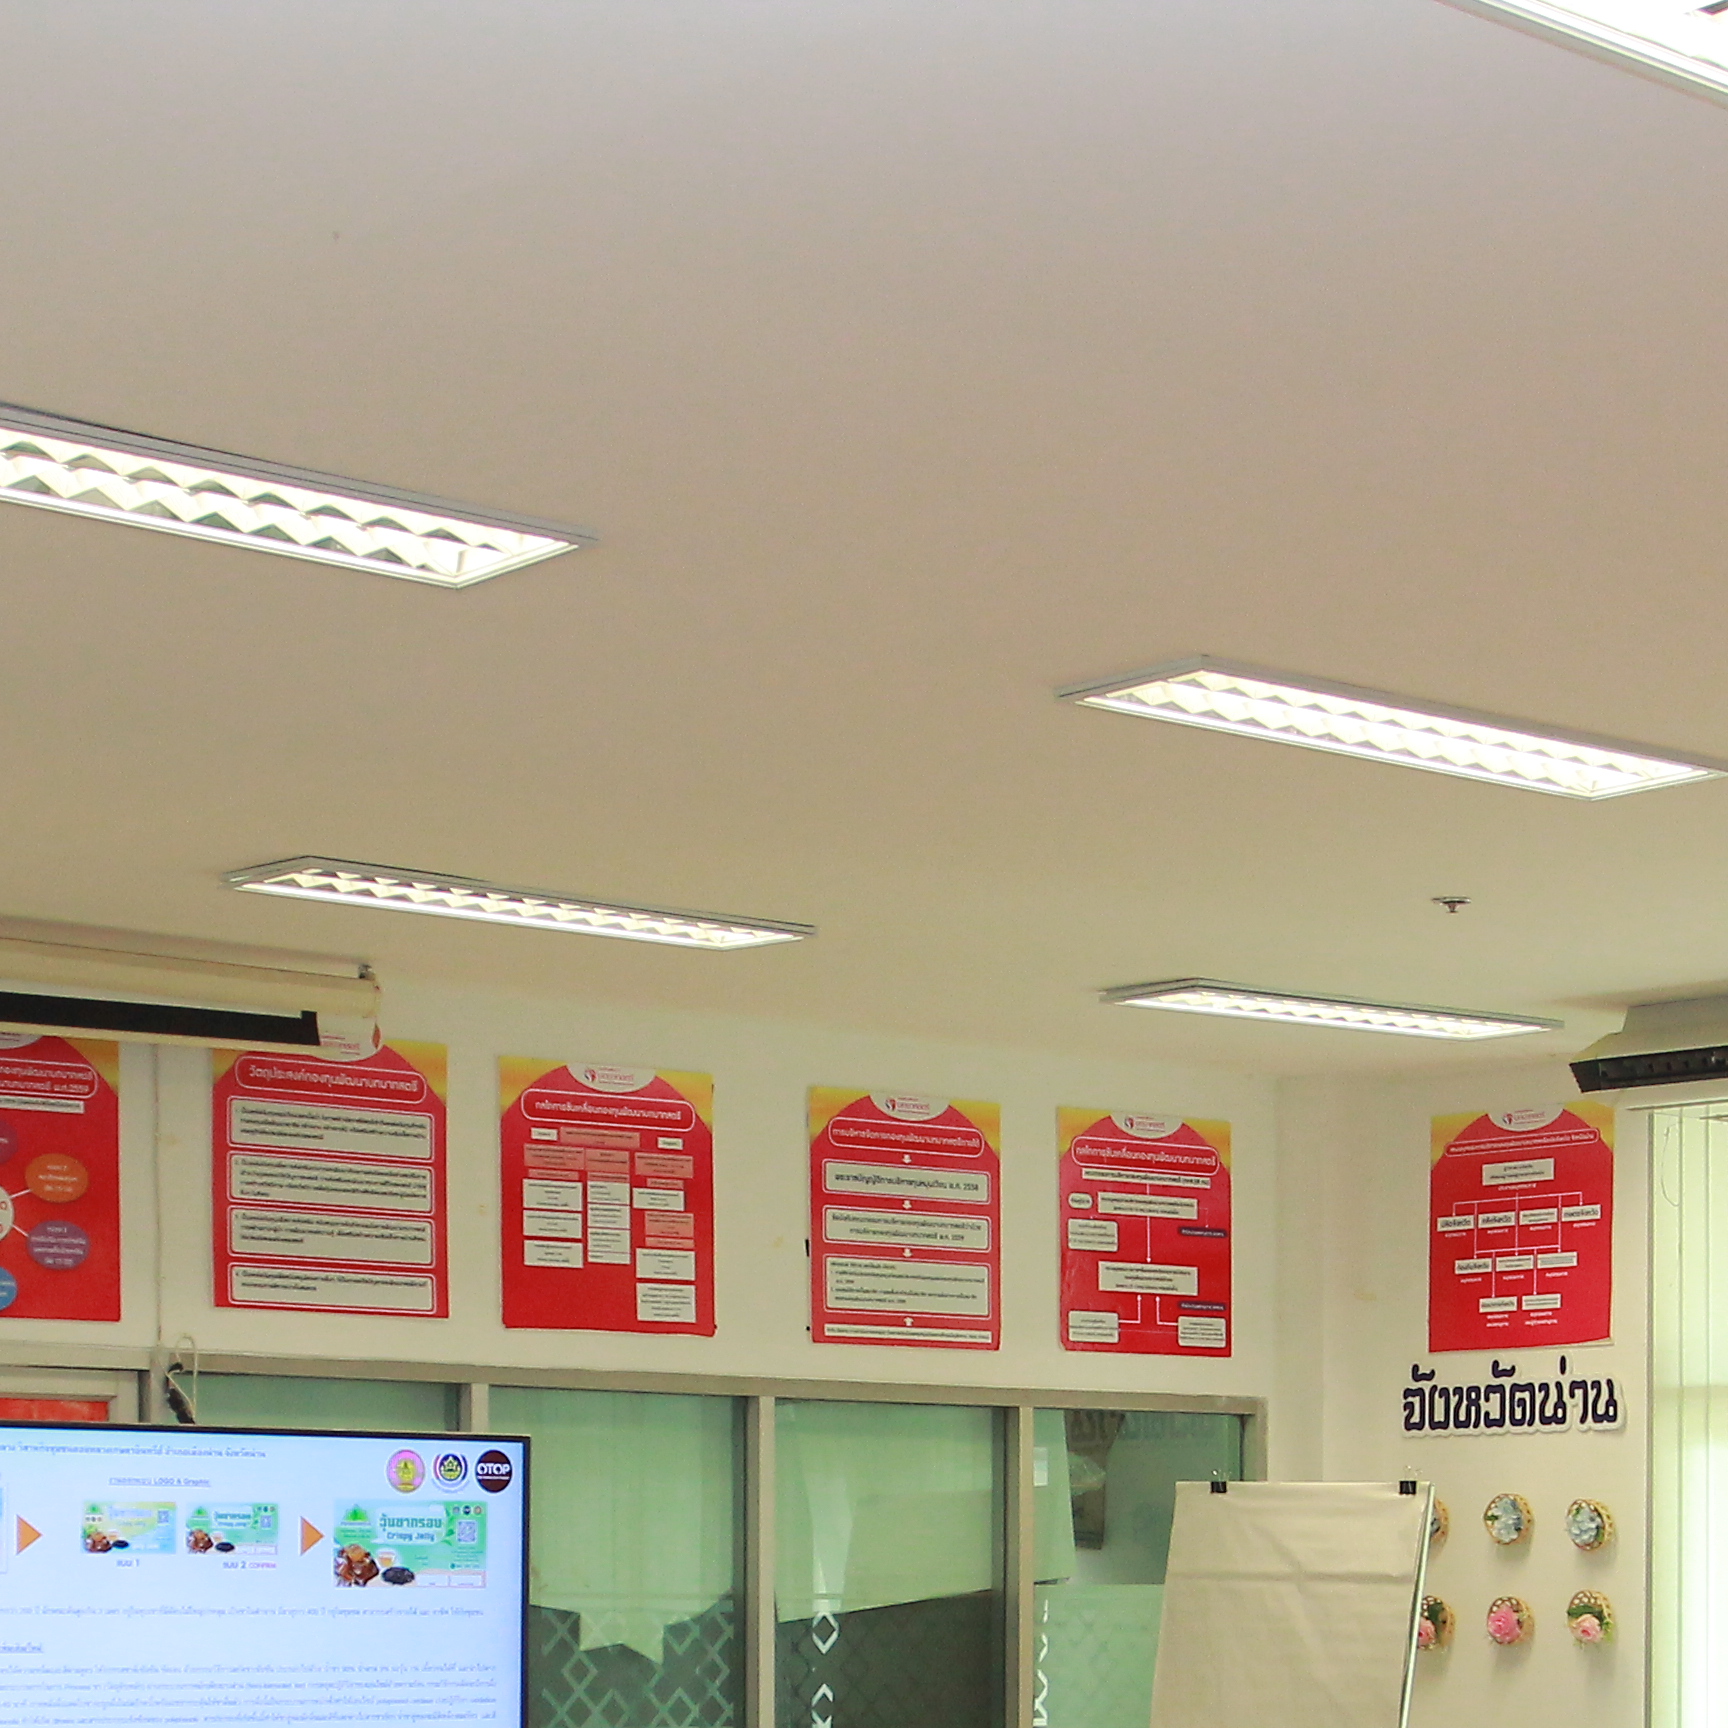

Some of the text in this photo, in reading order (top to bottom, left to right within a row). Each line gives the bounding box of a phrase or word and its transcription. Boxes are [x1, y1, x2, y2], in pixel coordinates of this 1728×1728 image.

[1402, 1355, 1619, 1431] จังหวัดน่าน
[477, 1463, 510, 1475] OTOP
[154, 1477, 175, 1486] LOGO
[387, 1531, 435, 1542] Crispy Jelly
[240, 1560, 247, 1570] 2
